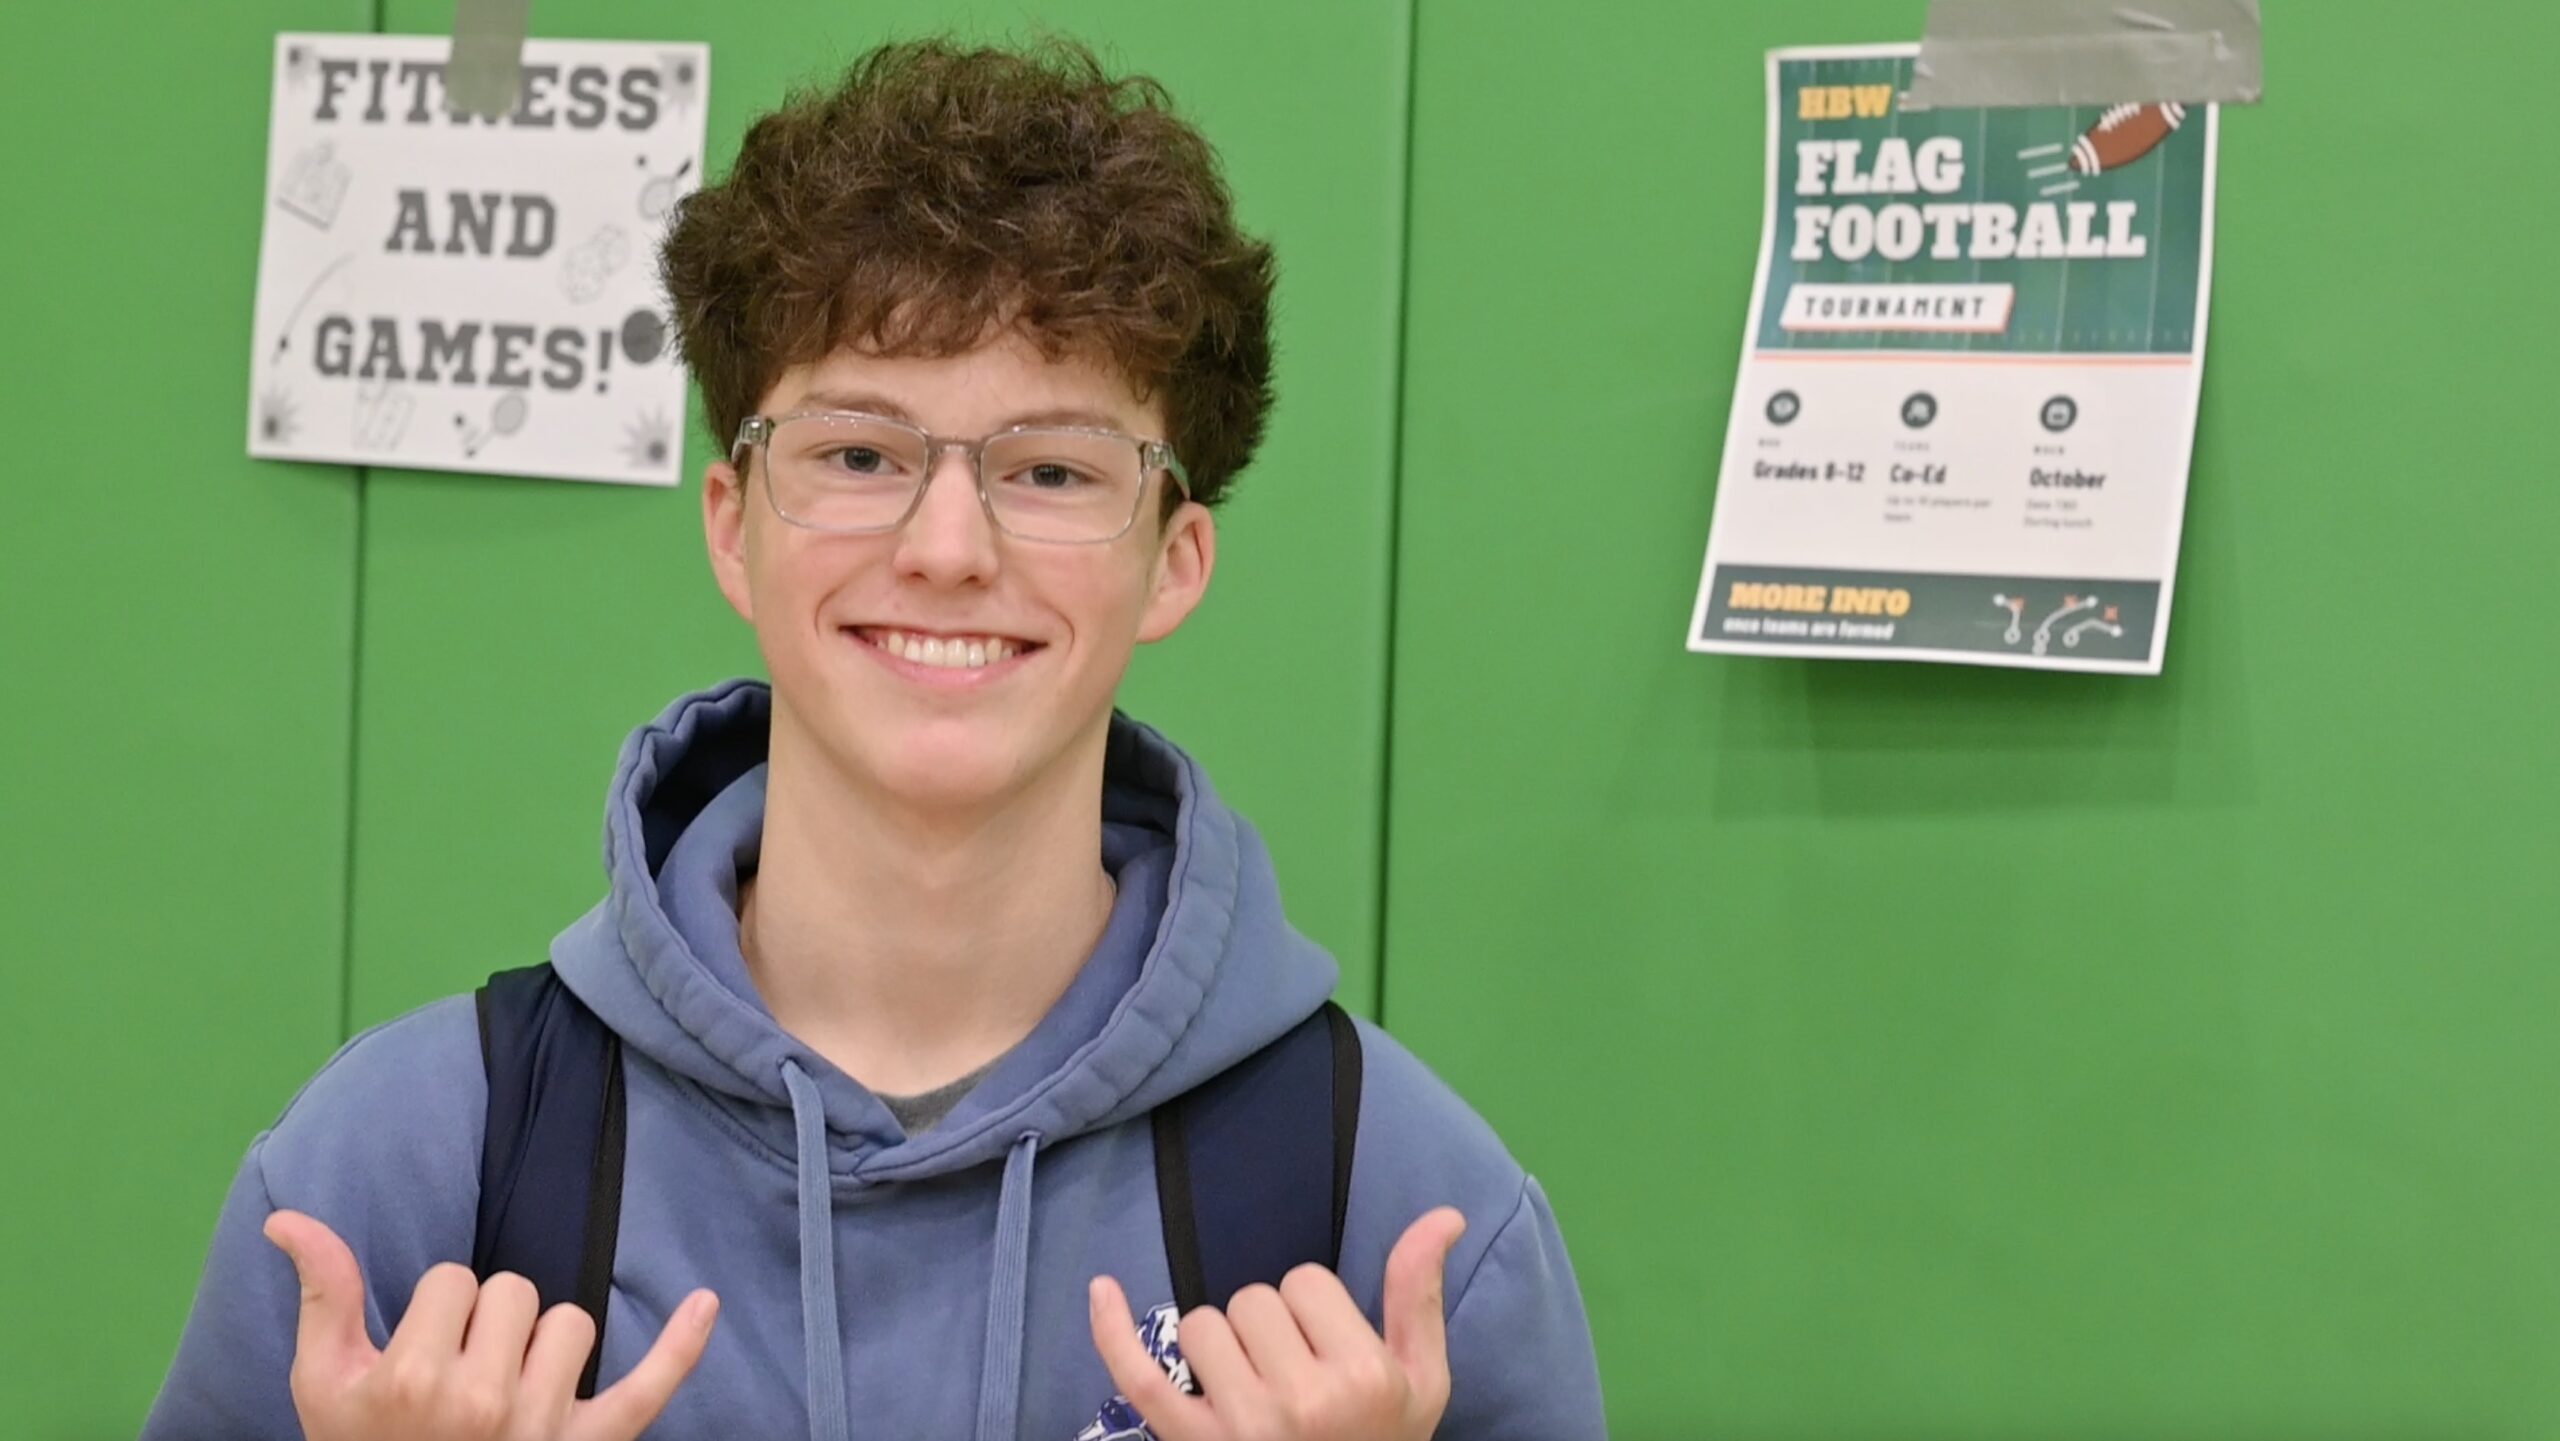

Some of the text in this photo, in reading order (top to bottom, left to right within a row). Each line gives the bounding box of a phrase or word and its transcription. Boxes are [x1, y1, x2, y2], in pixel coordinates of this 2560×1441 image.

[315, 60, 660, 131] FITESS
[1798, 85, 1892, 120] HBW
[1795, 136, 1964, 195] FLAG
[384, 189, 557, 258] AND
[1791, 201, 2146, 261] FOOTBALL
[1804, 296, 1985, 318] TOURNAMENT
[313, 316, 614, 394] GAMES!
[1754, 459, 1818, 479] Grades
[1890, 463, 1947, 484] Co-Ed
[2029, 467, 2106, 488] October
[1729, 582, 1911, 616] MORE INFO
[1811, 621, 1837, 638] are
[1839, 619, 1895, 640] formed
